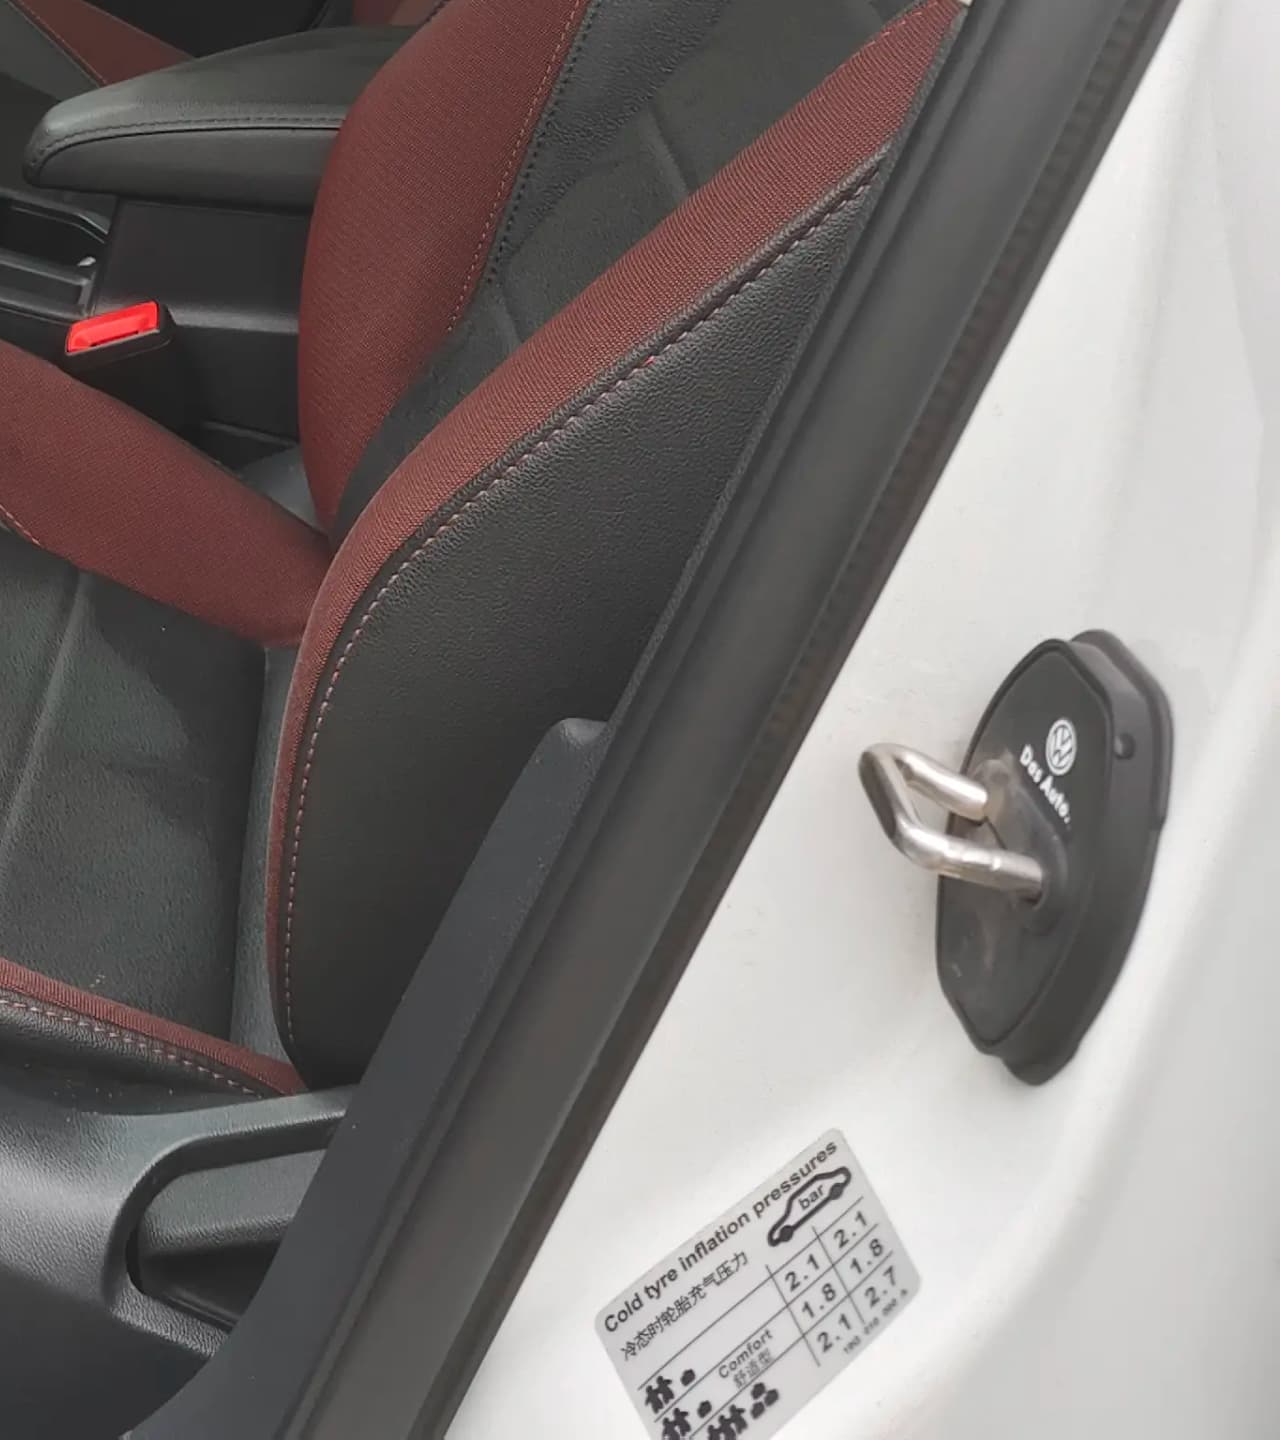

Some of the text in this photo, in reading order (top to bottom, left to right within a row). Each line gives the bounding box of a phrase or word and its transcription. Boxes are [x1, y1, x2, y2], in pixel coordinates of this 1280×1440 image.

[1020, 744, 1042, 782] Das
[798, 1184, 827, 1212] bar
[603, 1140, 839, 1333] Cold tyre inflation pressures
[784, 1210, 870, 1292] 2.1 2.1
[620, 1249, 749, 1362] 冷态时轮胎充气压力
[718, 1238, 885, 1380] Comfort 1.8 1.8
[816, 1313, 853, 1353] 2.1
[733, 1347, 773, 1387] 舒适型
